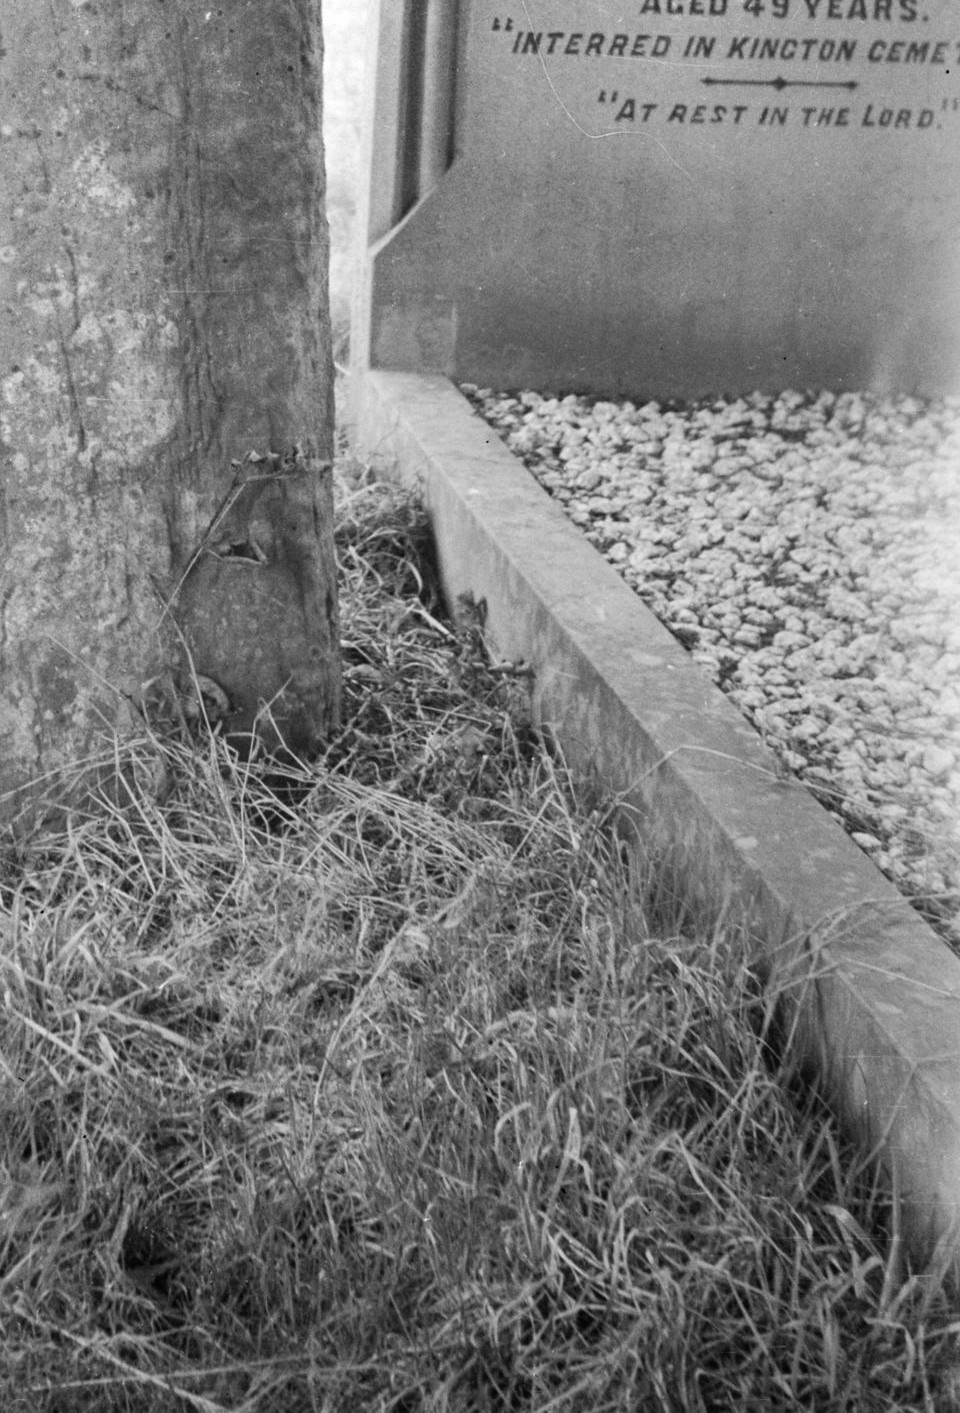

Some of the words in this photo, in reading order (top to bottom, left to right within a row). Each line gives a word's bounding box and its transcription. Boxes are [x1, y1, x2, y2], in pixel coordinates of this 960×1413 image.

[683, 36, 716, 58] IN
[667, 103, 748, 126] REST
[759, 106, 789, 127] IN
[801, 107, 850, 128] THE
